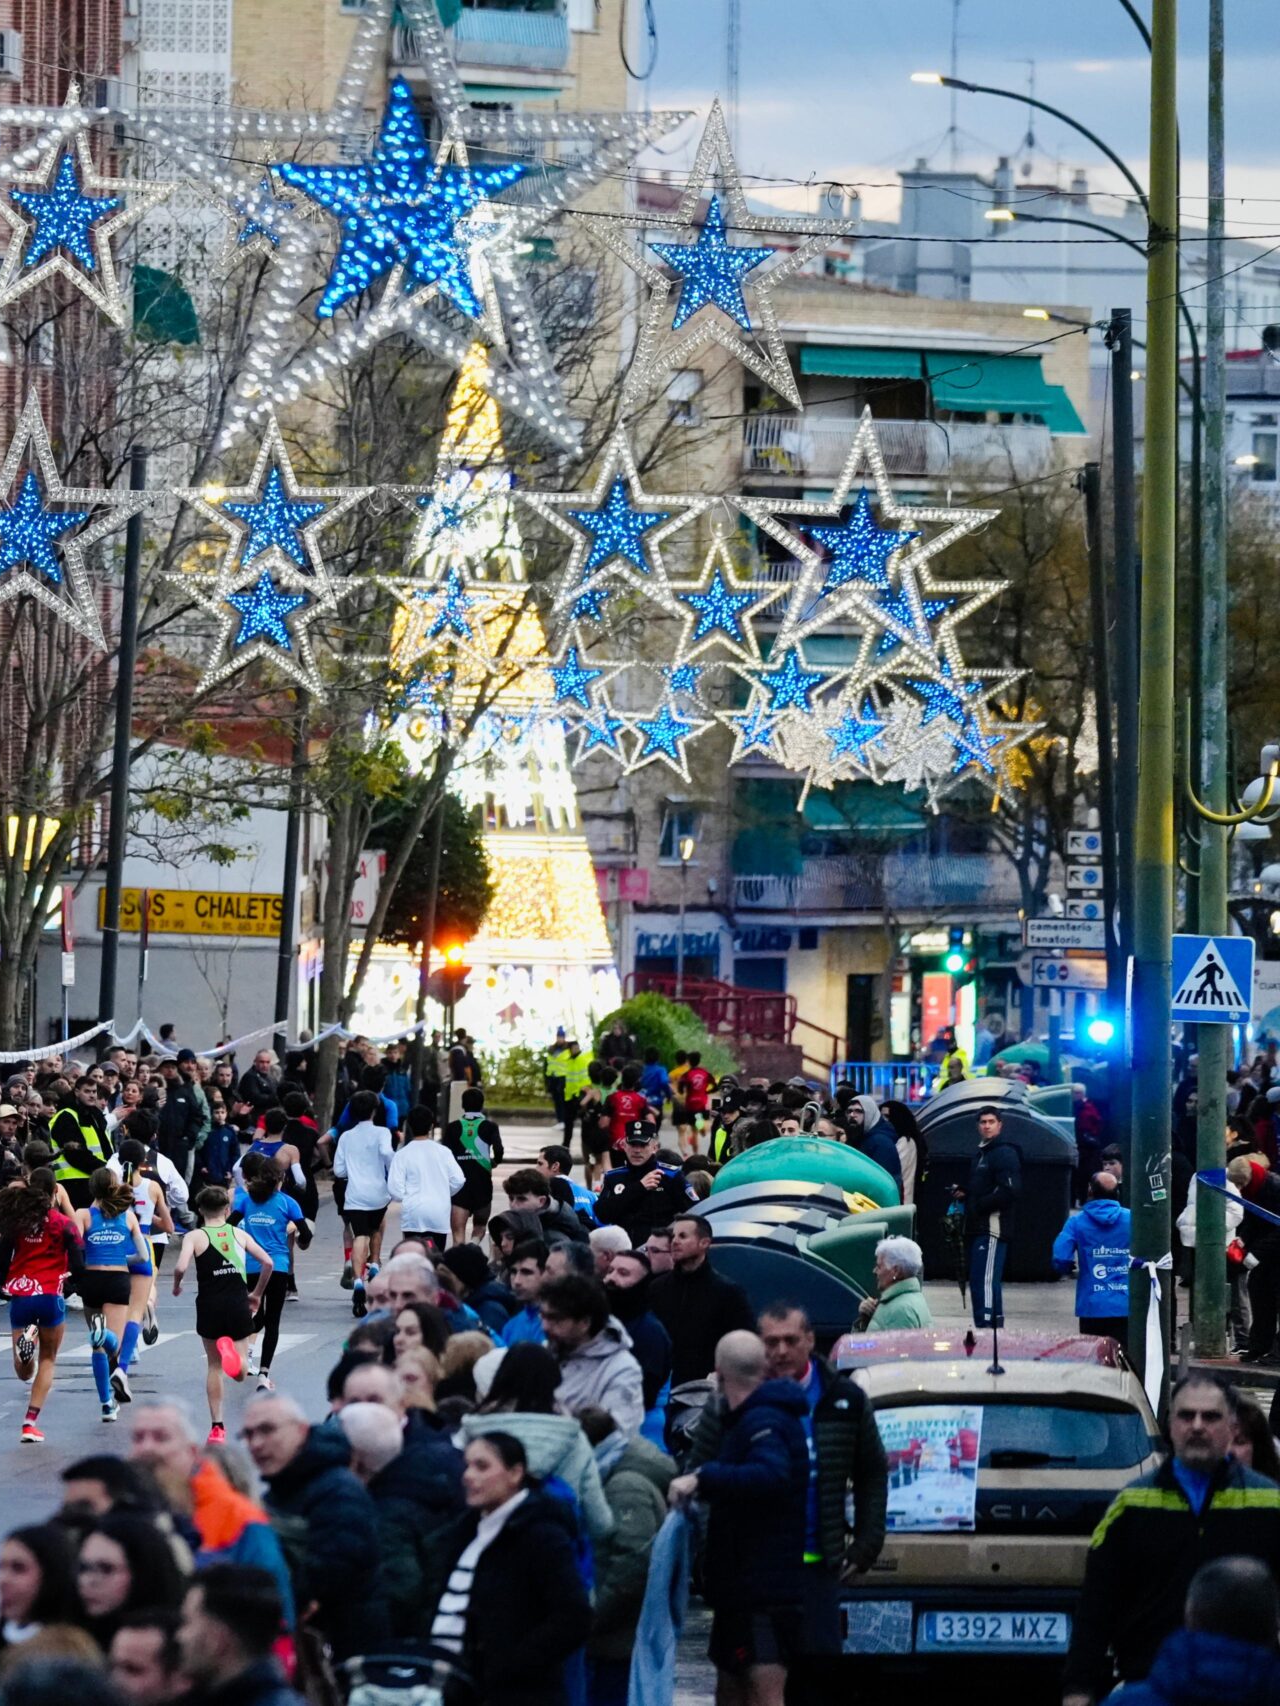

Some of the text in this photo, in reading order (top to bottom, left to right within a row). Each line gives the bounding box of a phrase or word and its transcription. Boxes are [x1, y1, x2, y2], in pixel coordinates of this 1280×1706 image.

[1030, 922, 1092, 932] cementerio
[1030, 935, 1081, 945] tanatorio
[940, 1615, 1058, 1640] 3392 MXZ
